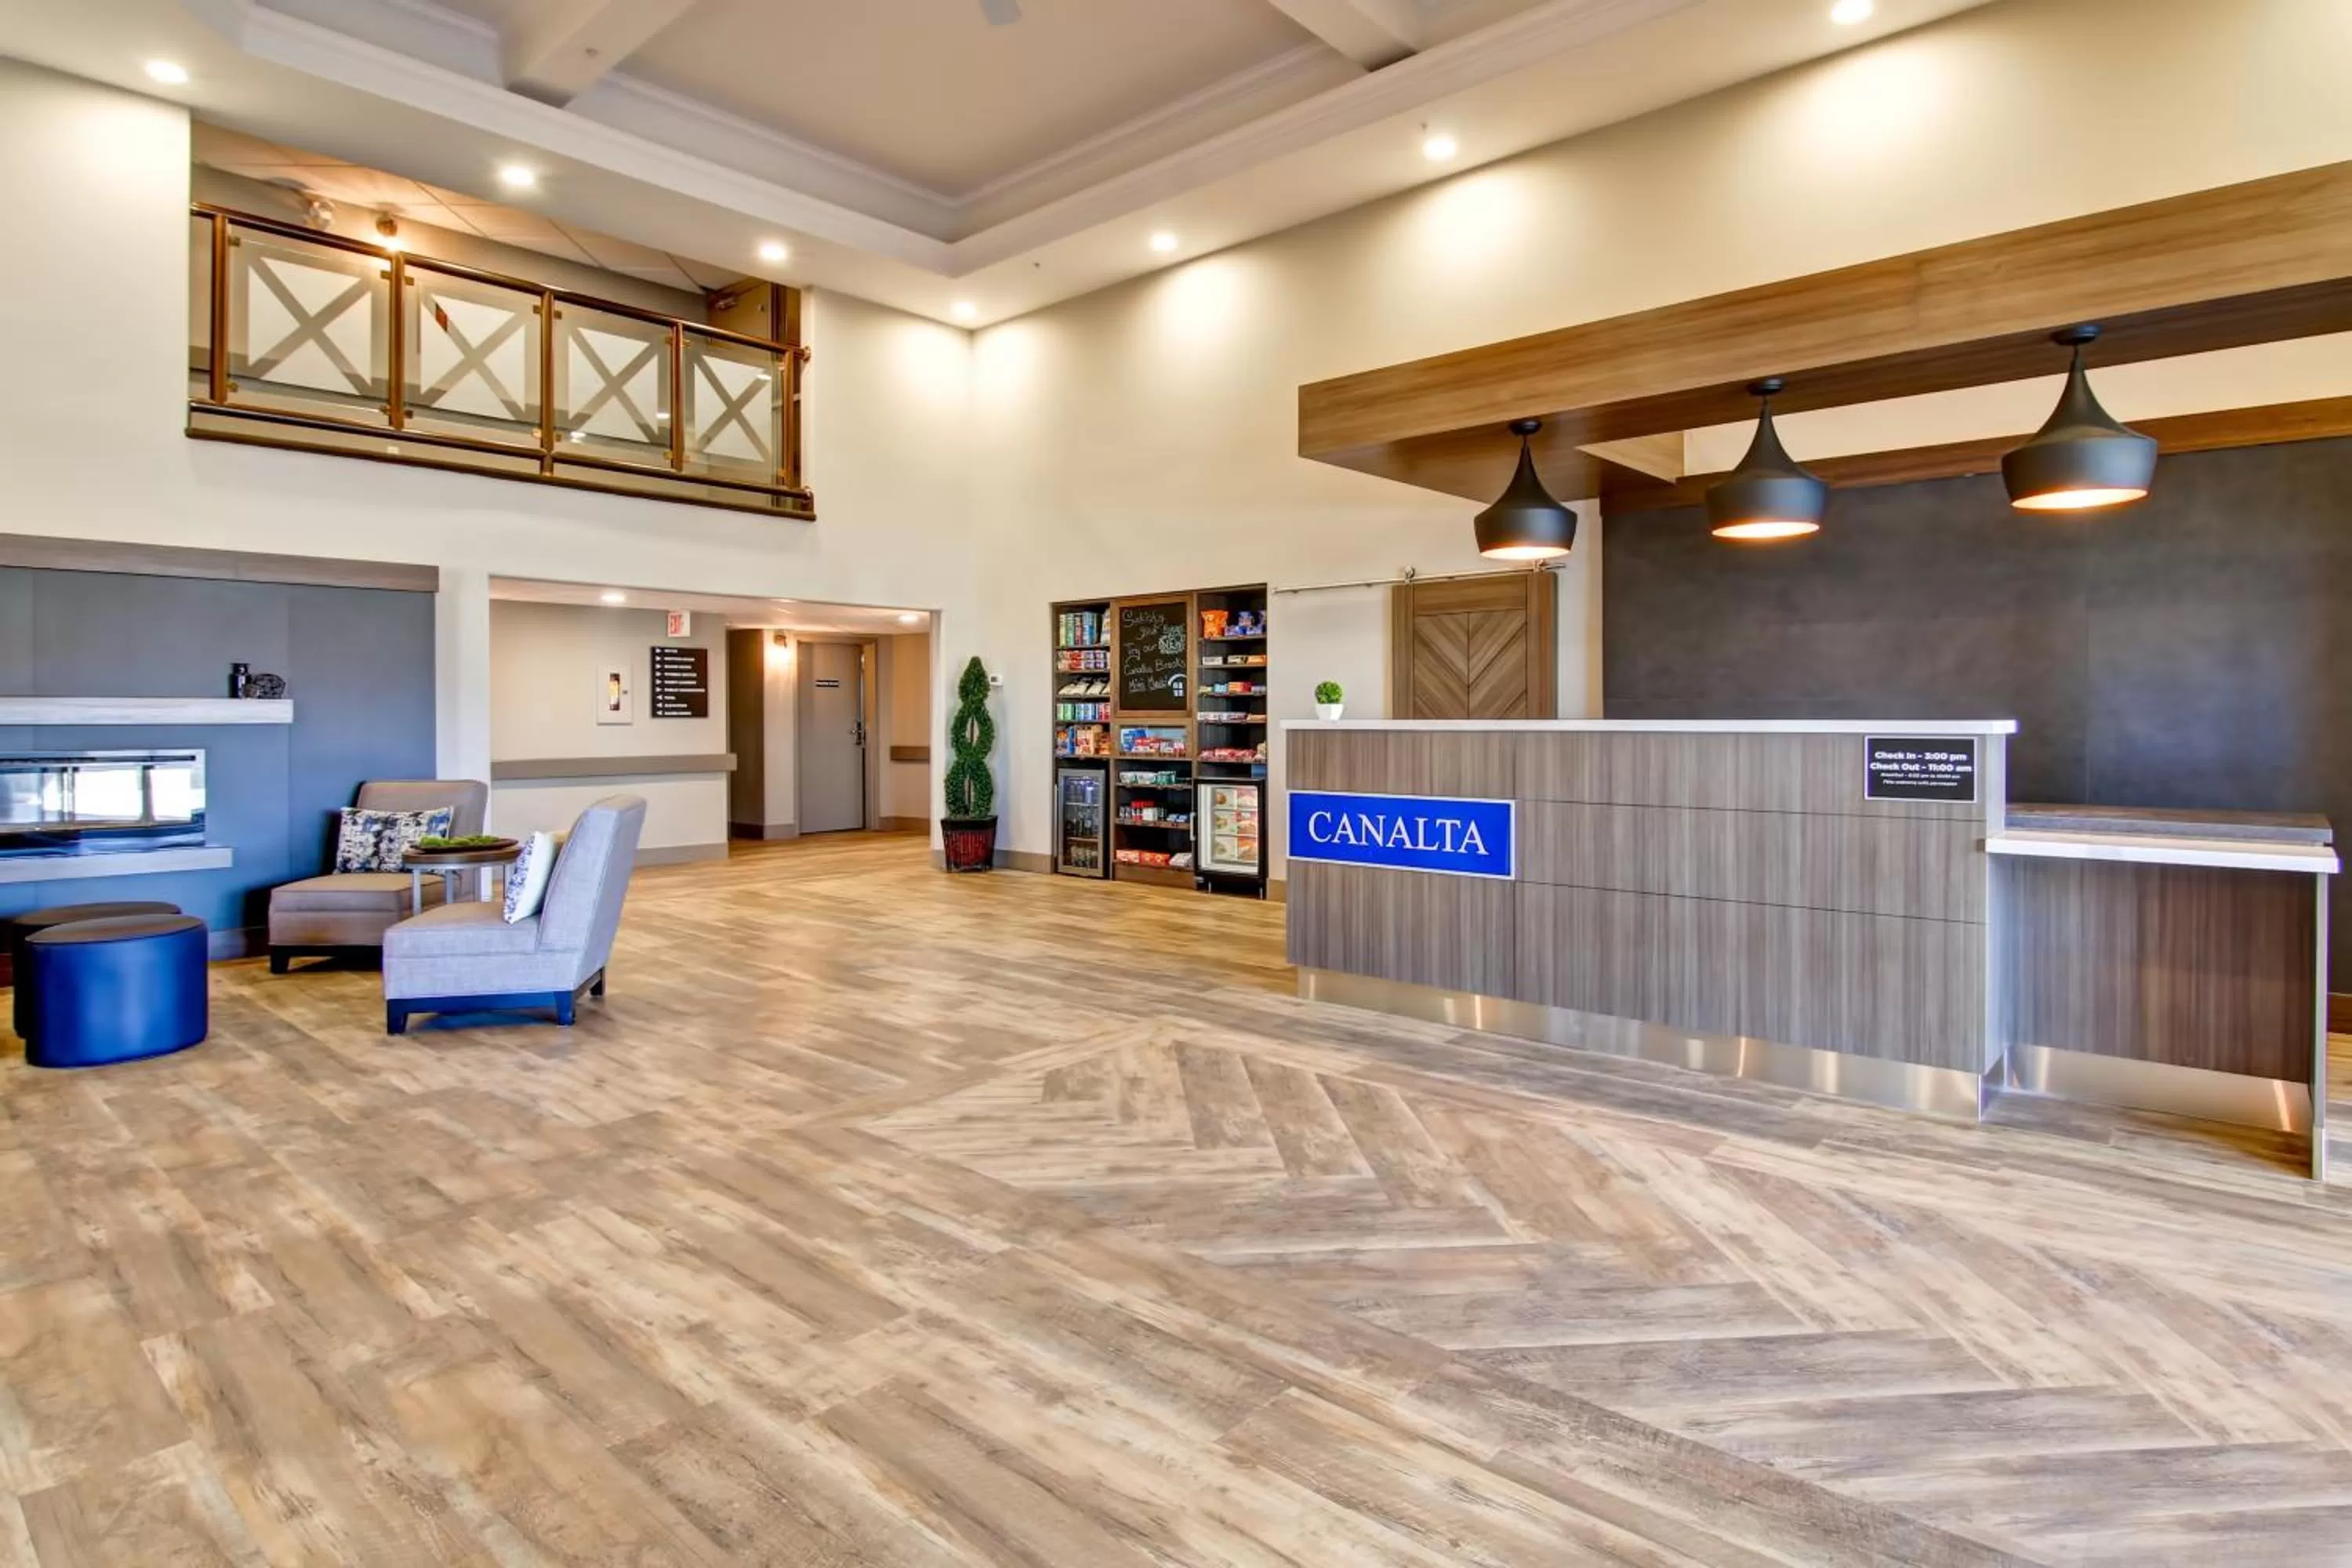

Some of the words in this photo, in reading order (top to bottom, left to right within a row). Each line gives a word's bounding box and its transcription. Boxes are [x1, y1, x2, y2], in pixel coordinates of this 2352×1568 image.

[1875, 751, 1905, 760] Check
[1906, 752, 1916, 760] In
[1925, 752, 1947, 760] 3:00
[1949, 753, 1967, 762] pm
[1870, 762, 1900, 771] Check
[1901, 763, 1920, 771] Out
[1928, 764, 1954, 772] 11:00
[1308, 811, 1490, 855] CANALTA
